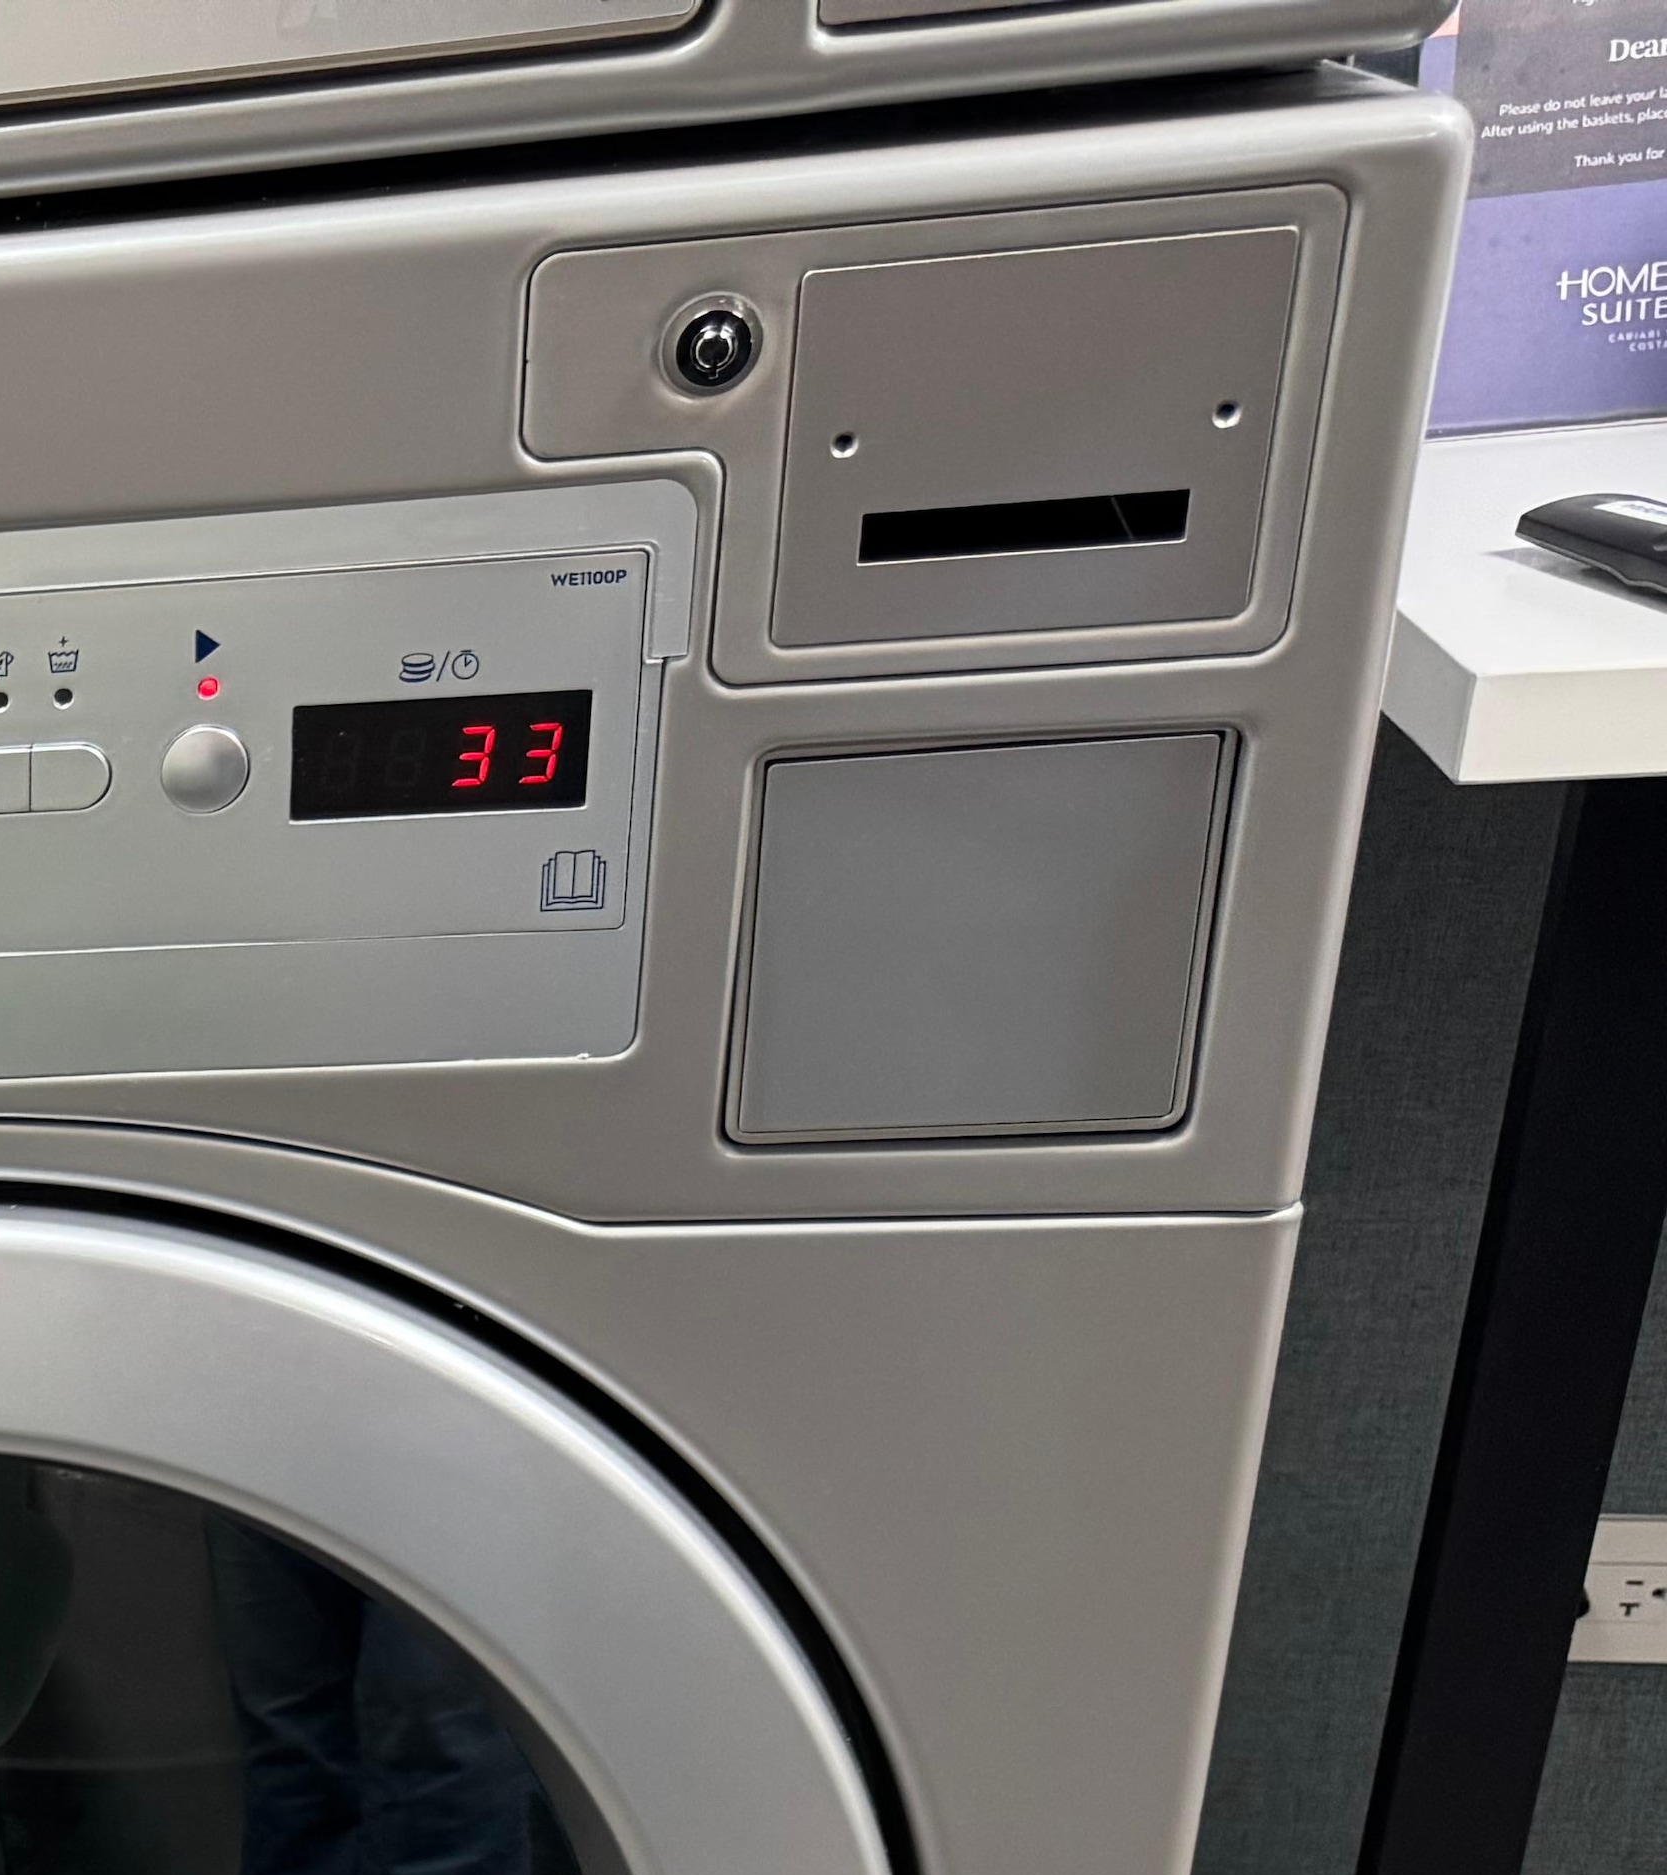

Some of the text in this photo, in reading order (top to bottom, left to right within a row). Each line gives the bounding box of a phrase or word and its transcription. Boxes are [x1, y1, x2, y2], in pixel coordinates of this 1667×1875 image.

[1499, 103, 1541, 116] Please
[1543, 99, 1561, 112] do
[1564, 96, 1586, 109] not
[1590, 94, 1623, 107] leave
[1626, 89, 1657, 105] your
[1481, 125, 1514, 138] After
[1518, 121, 1554, 135] using
[1557, 117, 1579, 131] the
[1574, 147, 1665, 168] Thank you for
[1556, 261, 1667, 300] HOME
[551, 569, 627, 587] WE1100P
[451, 722, 563, 787] 33
